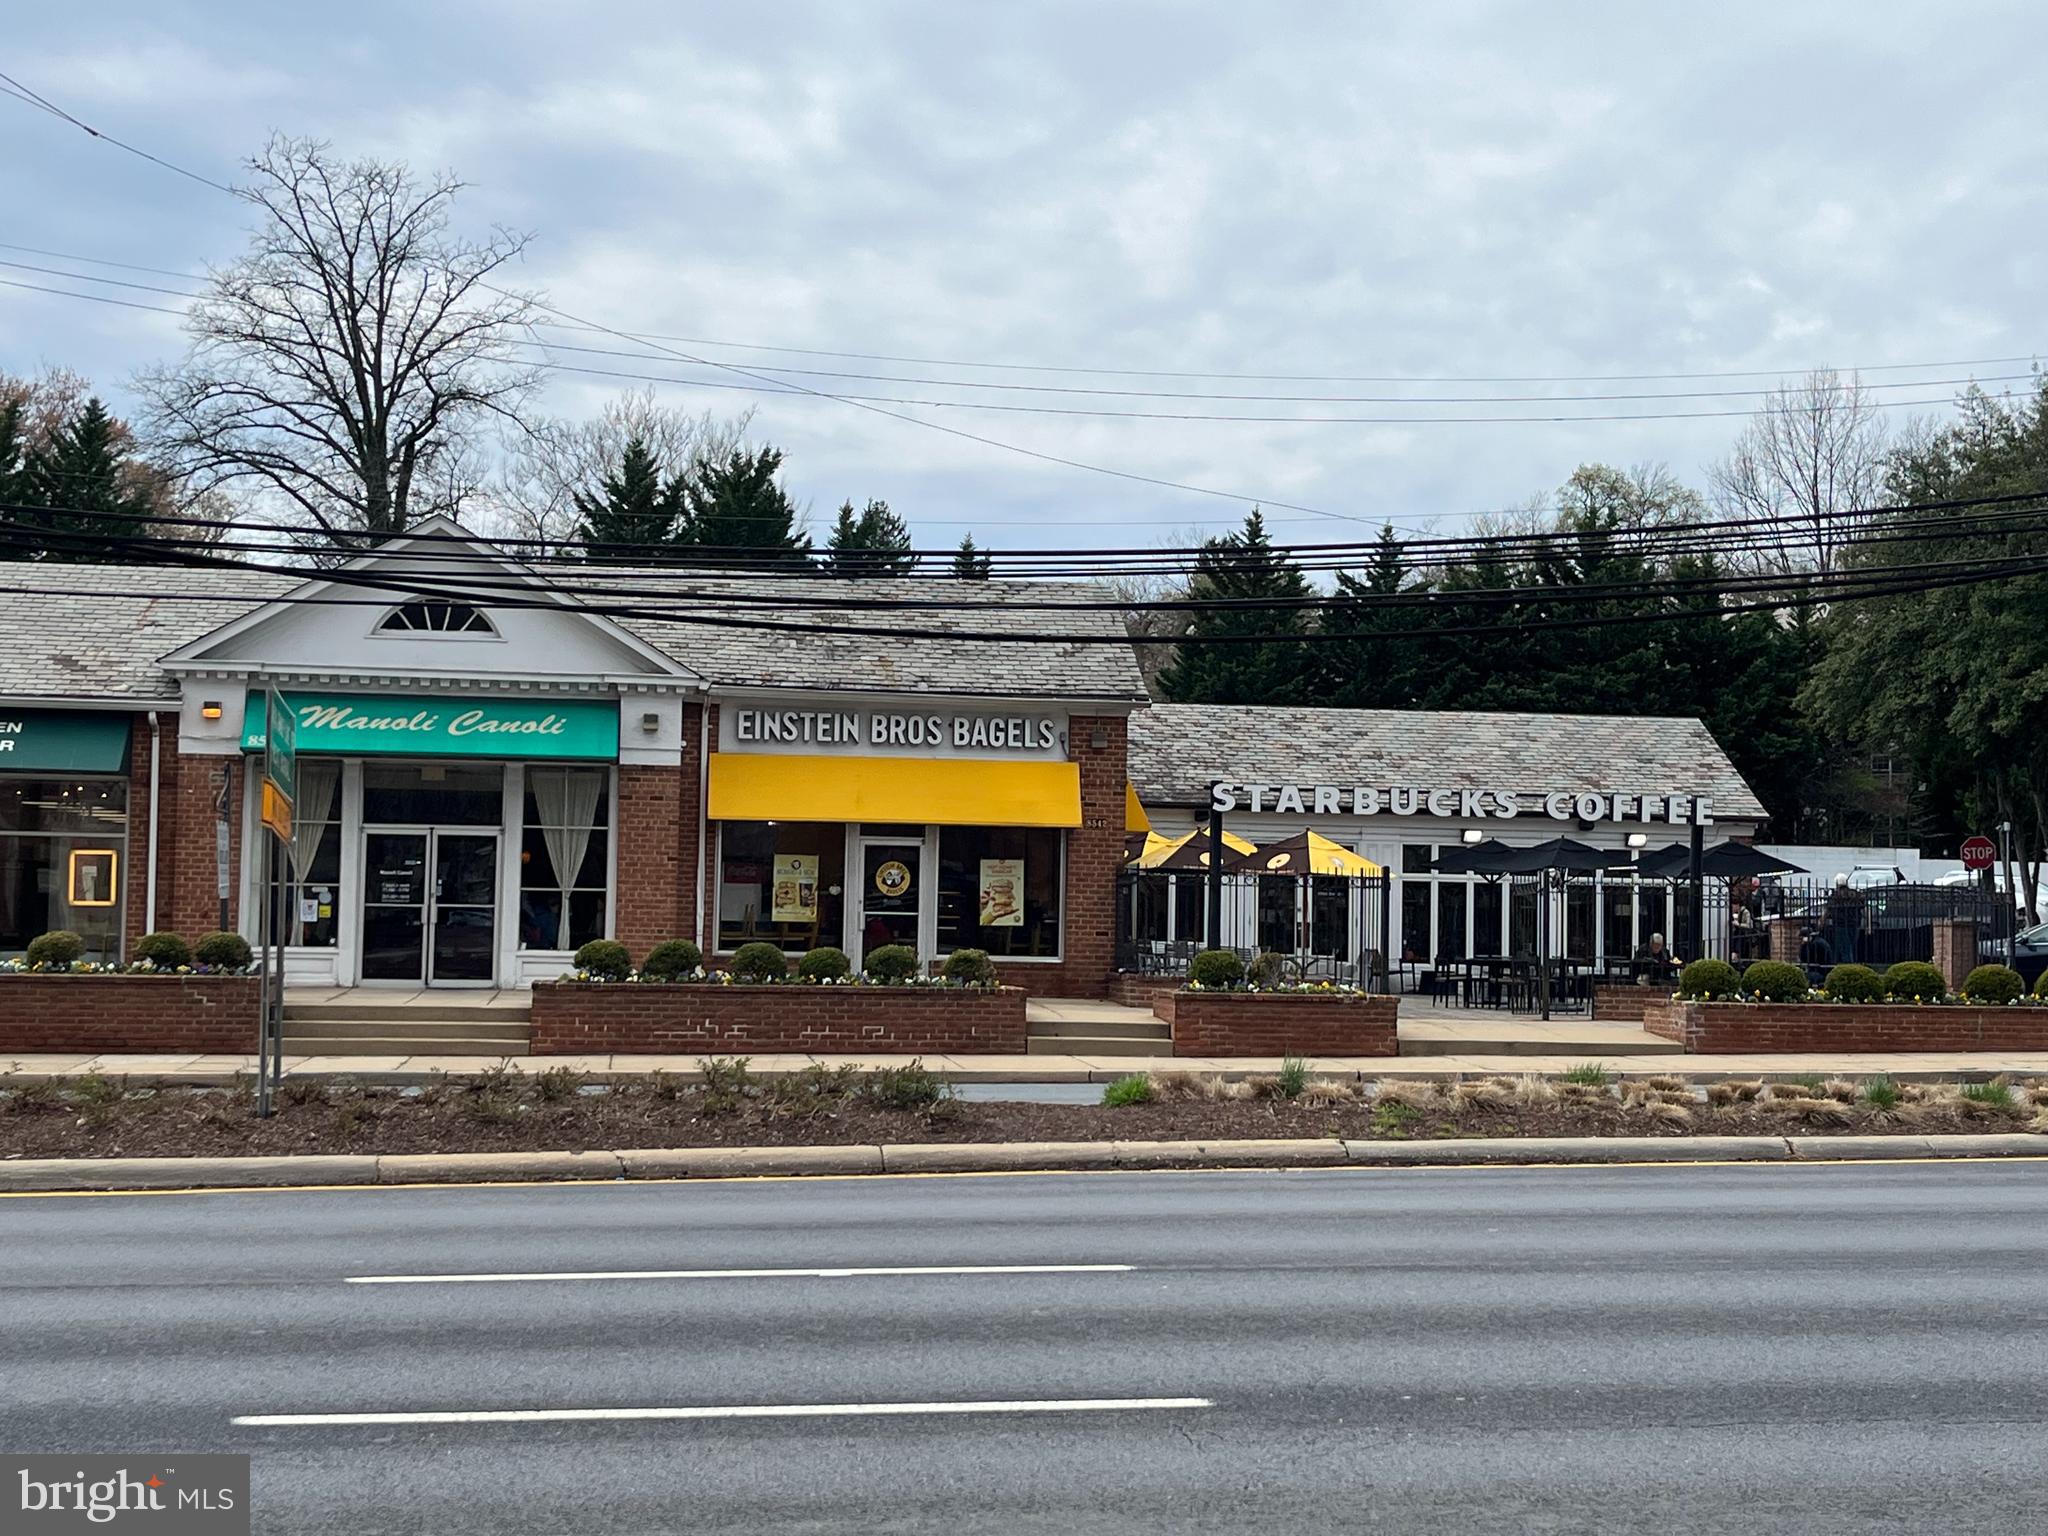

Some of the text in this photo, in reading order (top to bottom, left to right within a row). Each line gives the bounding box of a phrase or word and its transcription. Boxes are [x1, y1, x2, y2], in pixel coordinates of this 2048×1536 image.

[299, 705, 567, 736] Manoli Canoli
[737, 711, 1056, 749] EINSTEIN BROS BAGELS
[1212, 783, 1715, 825] STARBUCKS COFFEE
[1963, 847, 1993, 860] STOP
